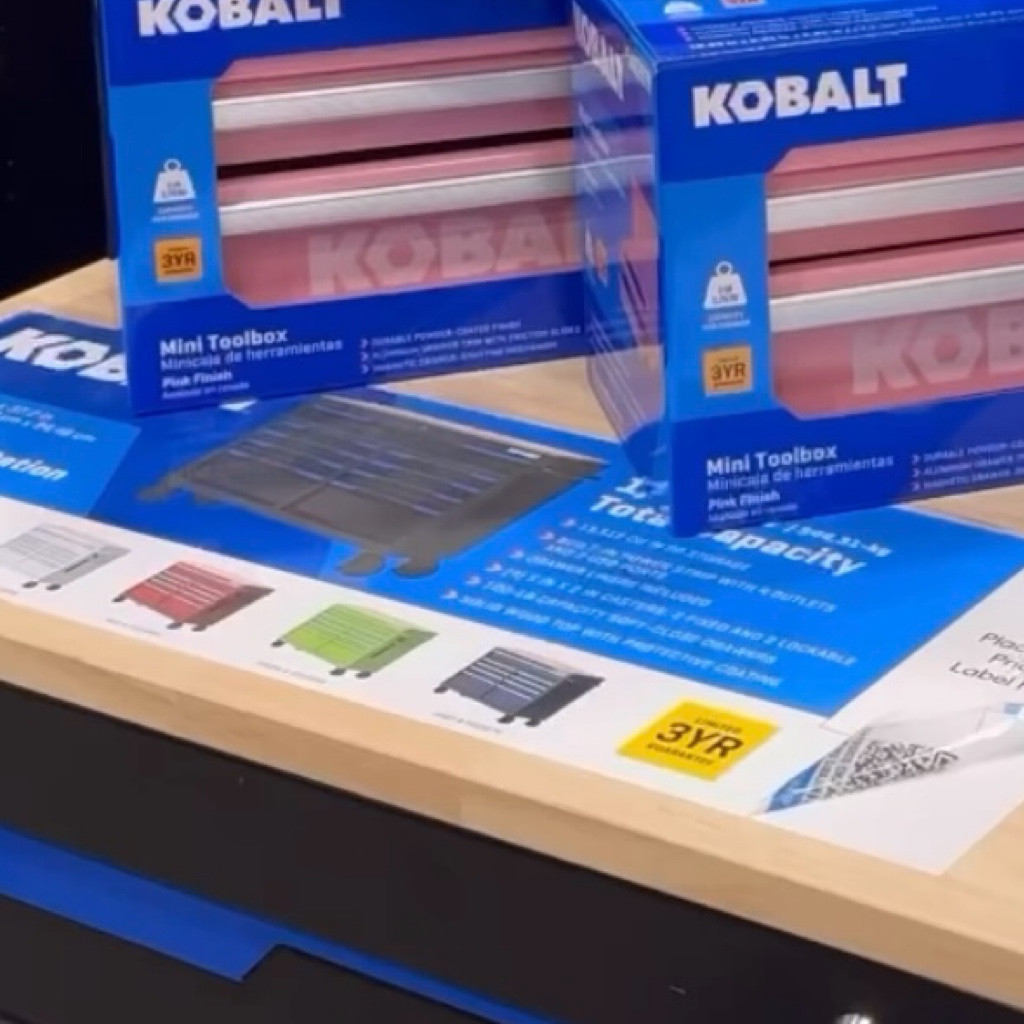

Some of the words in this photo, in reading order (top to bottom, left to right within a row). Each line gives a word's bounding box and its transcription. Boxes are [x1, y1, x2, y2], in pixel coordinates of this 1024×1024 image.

[691, 62, 908, 129] KOBALT
[161, 250, 197, 269] 3YR
[159, 335, 203, 357] Mini
[205, 328, 288, 351] Toolbox
[160, 354, 222, 371] Minicaja
[223, 350, 243, 364] de
[246, 339, 344, 362] herramientas
[193, 370, 233, 385] Finish
[710, 361, 747, 381] 3YR
[706, 452, 751, 475] Mini
[754, 444, 838, 469] Toolbox
[706, 473, 769, 491] Minicaja
[772, 468, 791, 483] de
[793, 455, 894, 479] herramientas
[694, 528, 868, 577] apacity
[949, 660, 1018, 688] Label
[655, 721, 746, 759] 3YR
